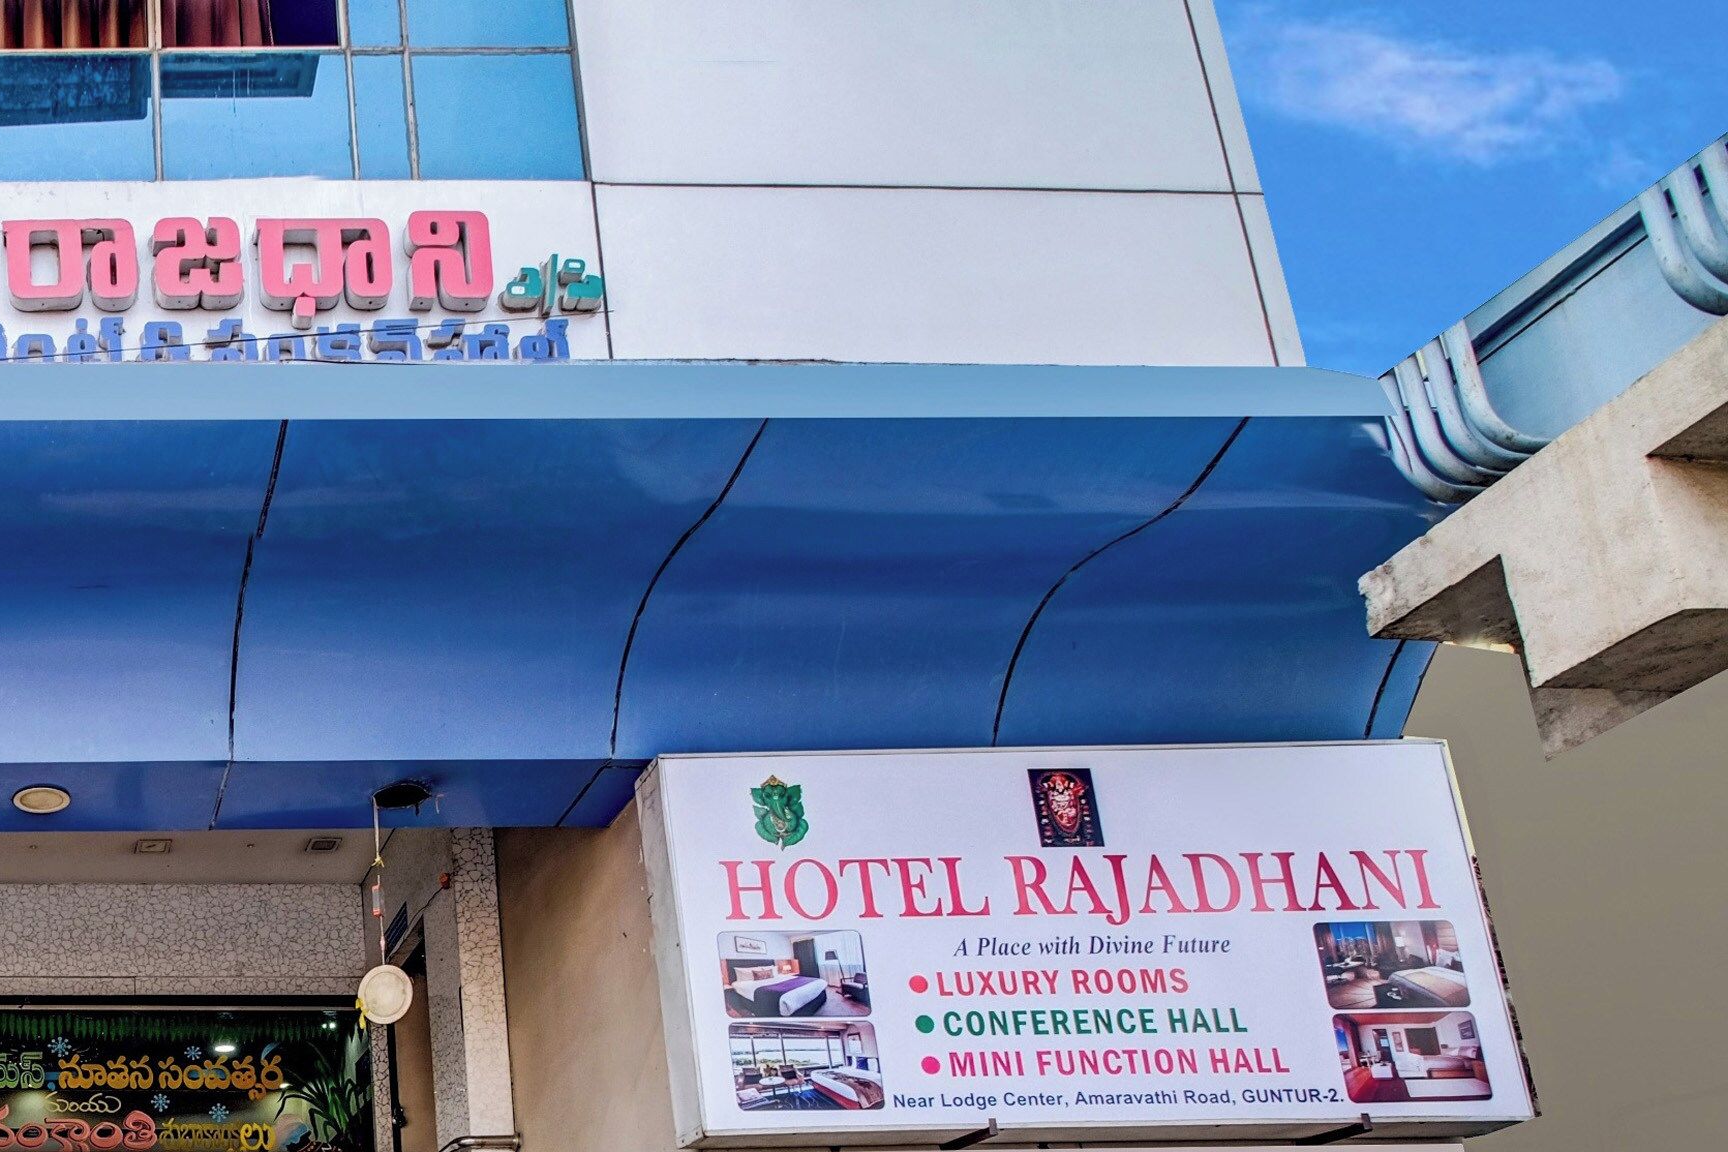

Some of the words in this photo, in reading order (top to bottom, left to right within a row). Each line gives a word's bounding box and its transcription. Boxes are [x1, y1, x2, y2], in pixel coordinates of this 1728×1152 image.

[1, 210, 495, 329] రాజధాని
[719, 857, 990, 920] HOTEL
[1010, 850, 1442, 926] RAJADHANI
[953, 937, 972, 956] A
[978, 937, 1036, 957] Place
[1042, 936, 1080, 955] with
[1090, 935, 1153, 954] Divine
[1163, 935, 1230, 953] Future
[936, 970, 1058, 996] LUXURY
[1071, 969, 1188, 994] ROOMS
[944, 1009, 1157, 1036] CONFERENCE
[1167, 1008, 1248, 1033] HALL
[949, 1051, 1024, 1077] MINI
[1036, 1049, 1198, 1075] FUNCTION
[1209, 1048, 1290, 1073] HALL
[894, 1095, 934, 1108] Near
[941, 1093, 997, 1110] Lodge
[1004, 1092, 1068, 1107] Center,
[1075, 1090, 1177, 1105] Amaravathi
[1183, 1090, 1236, 1105] Road,
[1242, 1089, 1344, 1103] GUNTUR-2.
